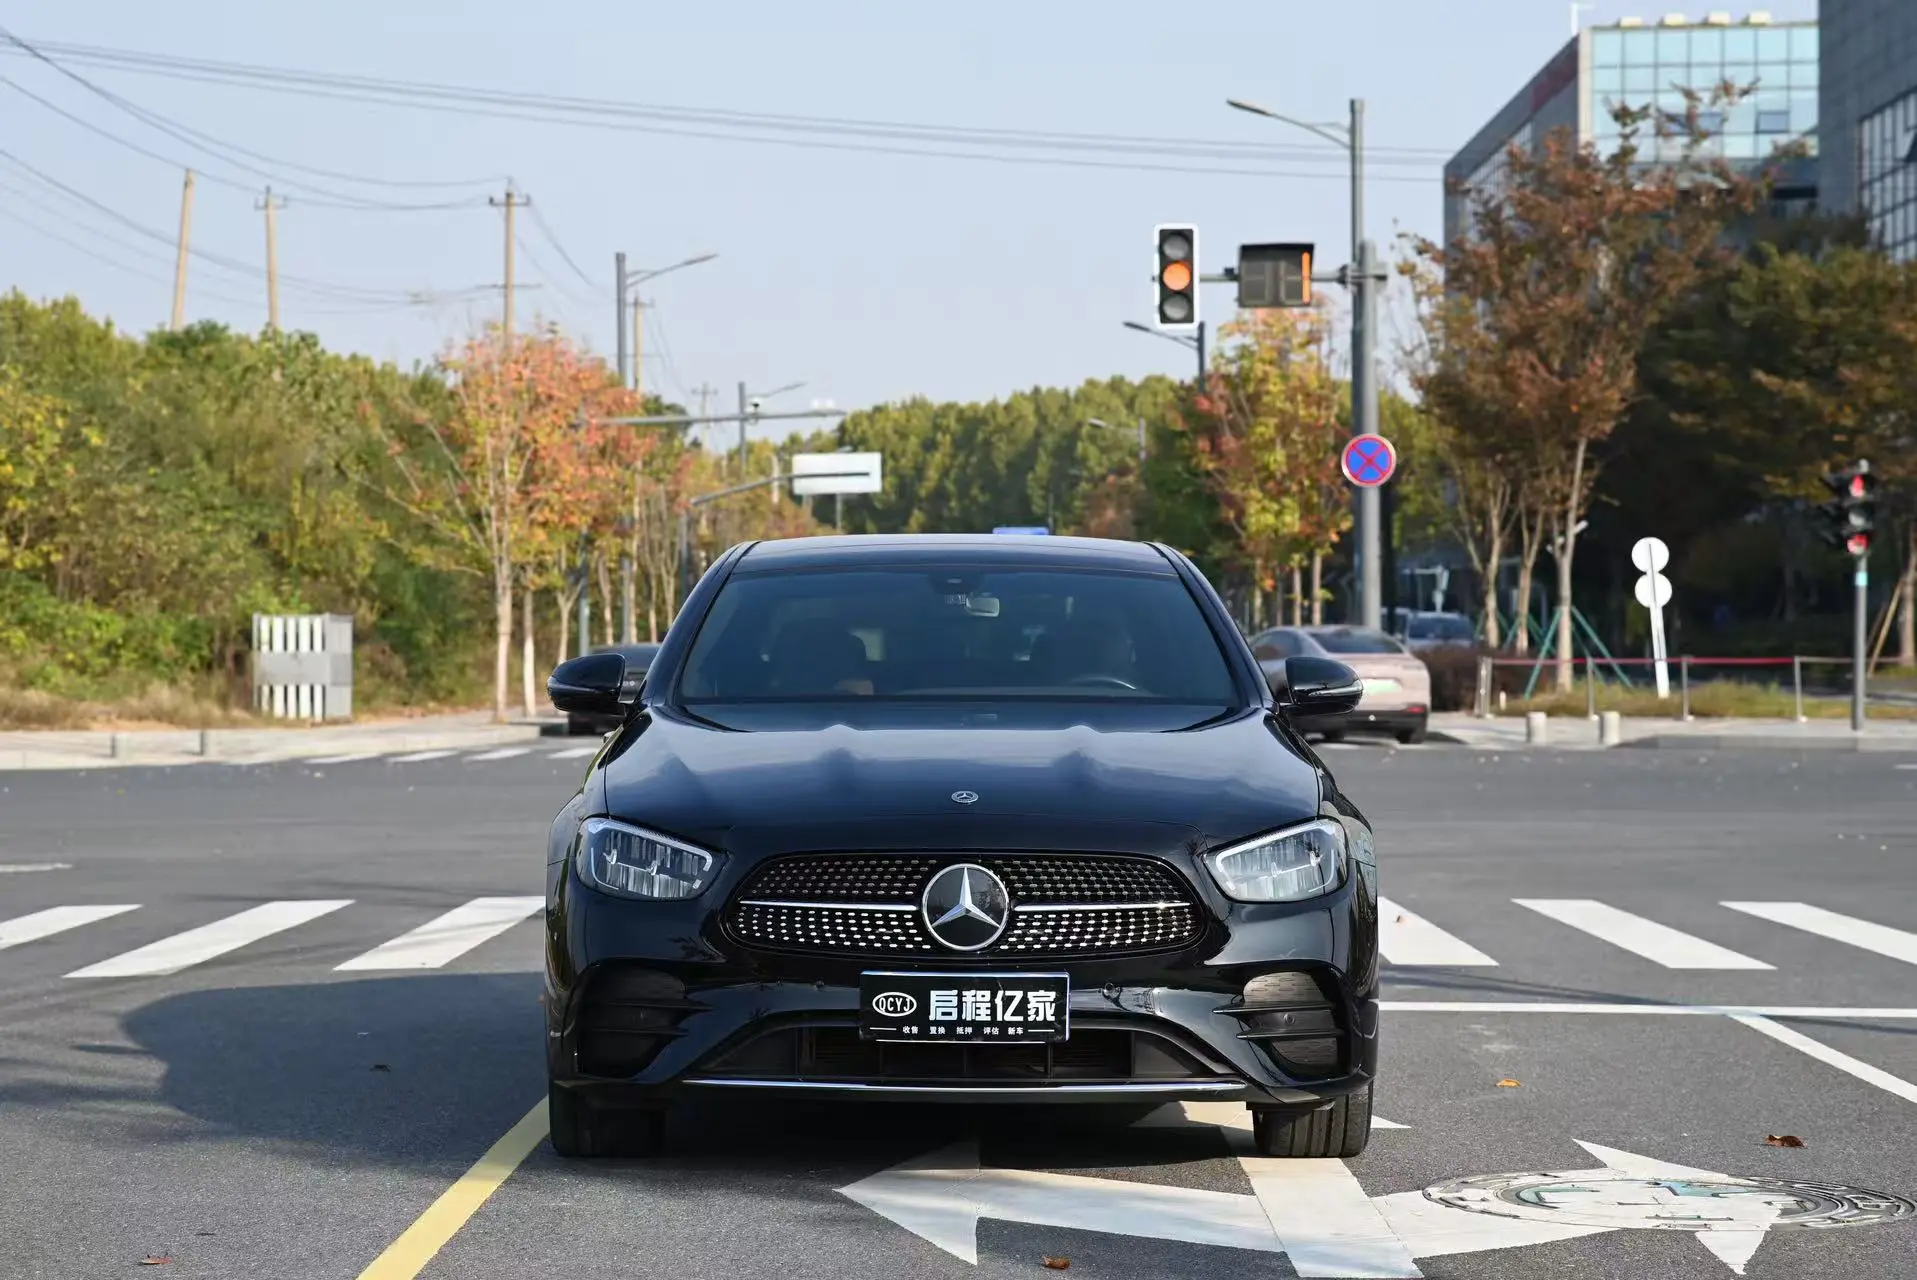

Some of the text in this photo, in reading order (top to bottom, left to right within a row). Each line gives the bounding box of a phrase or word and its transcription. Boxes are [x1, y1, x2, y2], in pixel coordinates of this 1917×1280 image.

[878, 994, 911, 1013] QCYJ
[928, 989, 1057, 1022] 启程亿家
[902, 1026, 1024, 1036] 收售 置换 抵押 评估 新车
